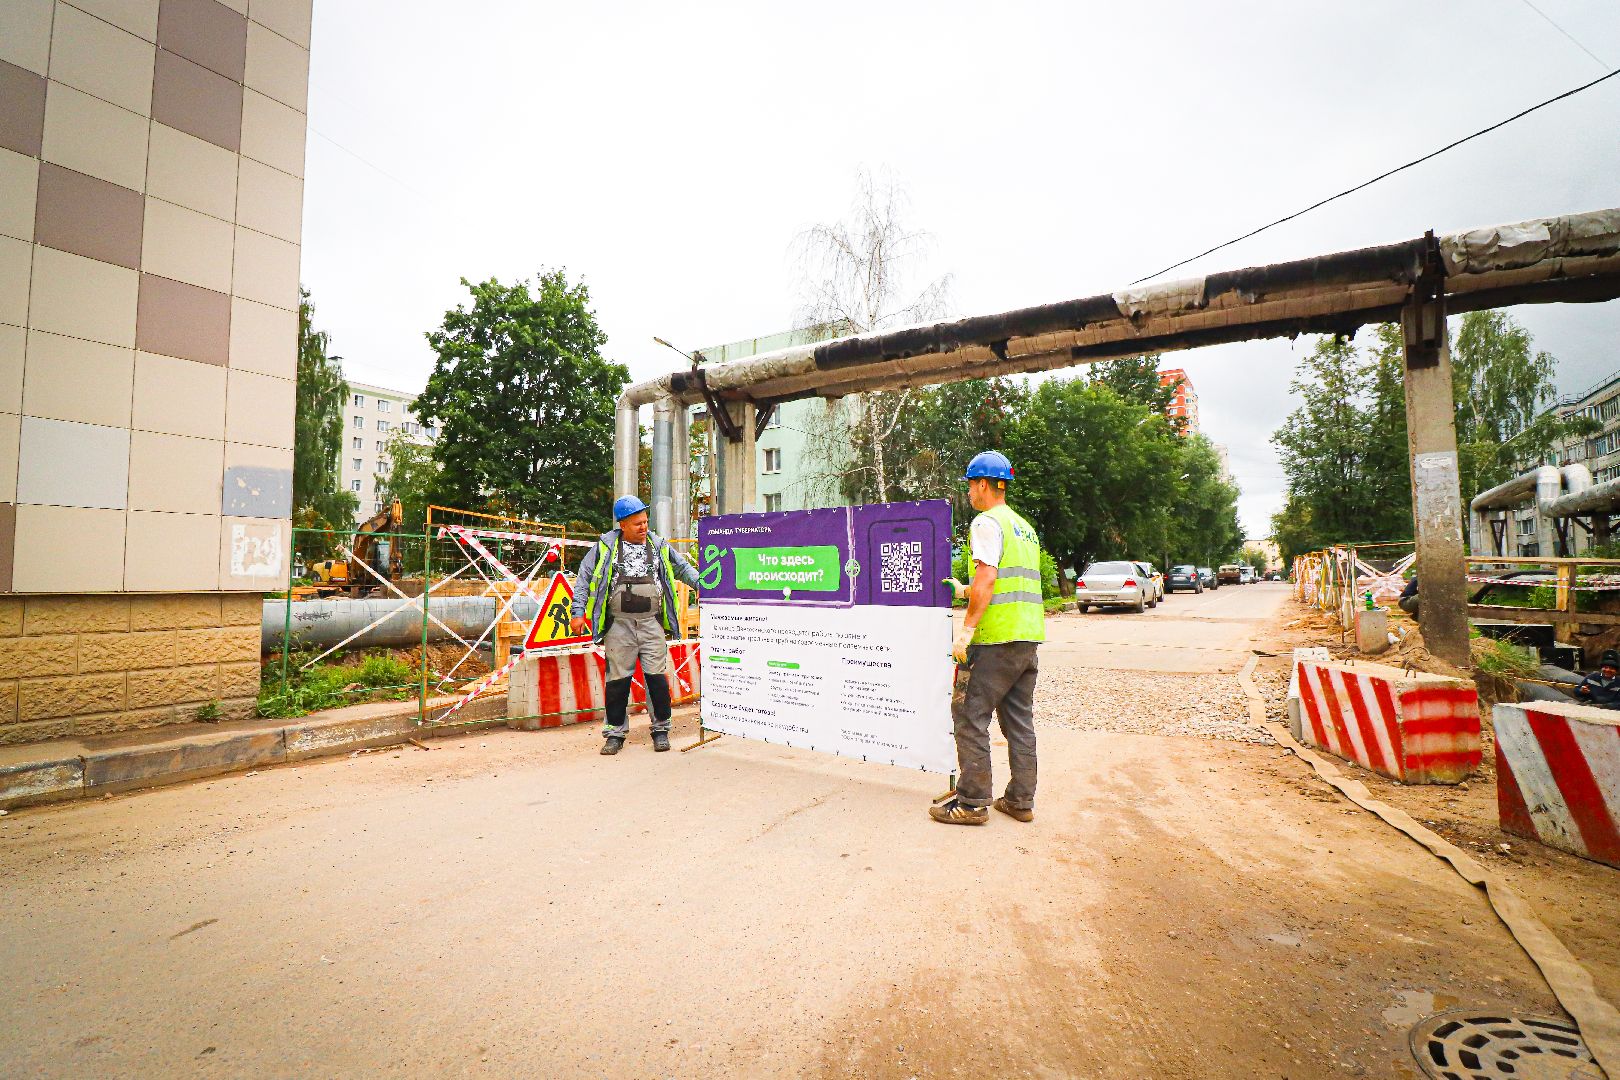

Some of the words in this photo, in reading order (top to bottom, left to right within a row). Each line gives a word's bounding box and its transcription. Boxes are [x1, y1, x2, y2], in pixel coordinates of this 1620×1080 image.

[735, 526, 772, 535] ГУБЕРНАТОРА
[758, 553, 778, 566] Что
[780, 554, 815, 566] здесь
[748, 568, 825, 584] происходит?
